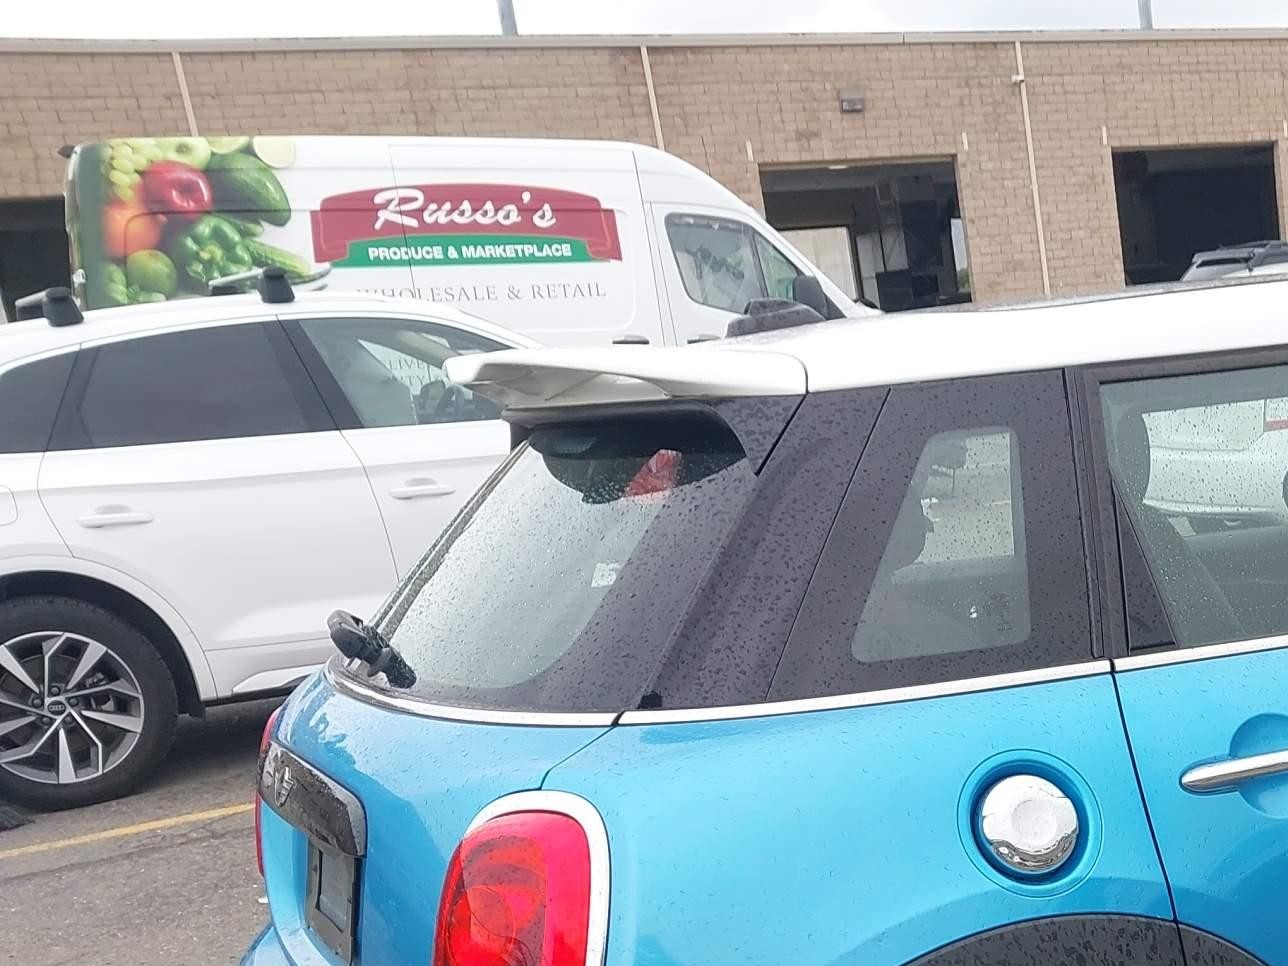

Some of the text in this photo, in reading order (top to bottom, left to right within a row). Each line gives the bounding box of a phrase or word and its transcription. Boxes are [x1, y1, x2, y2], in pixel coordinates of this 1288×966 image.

[373, 187, 557, 231] Russo's
[368, 243, 572, 261] PRODUCE & MARKETPLACE
[507, 284, 522, 300] &
[531, 281, 607, 300] RETAIL
